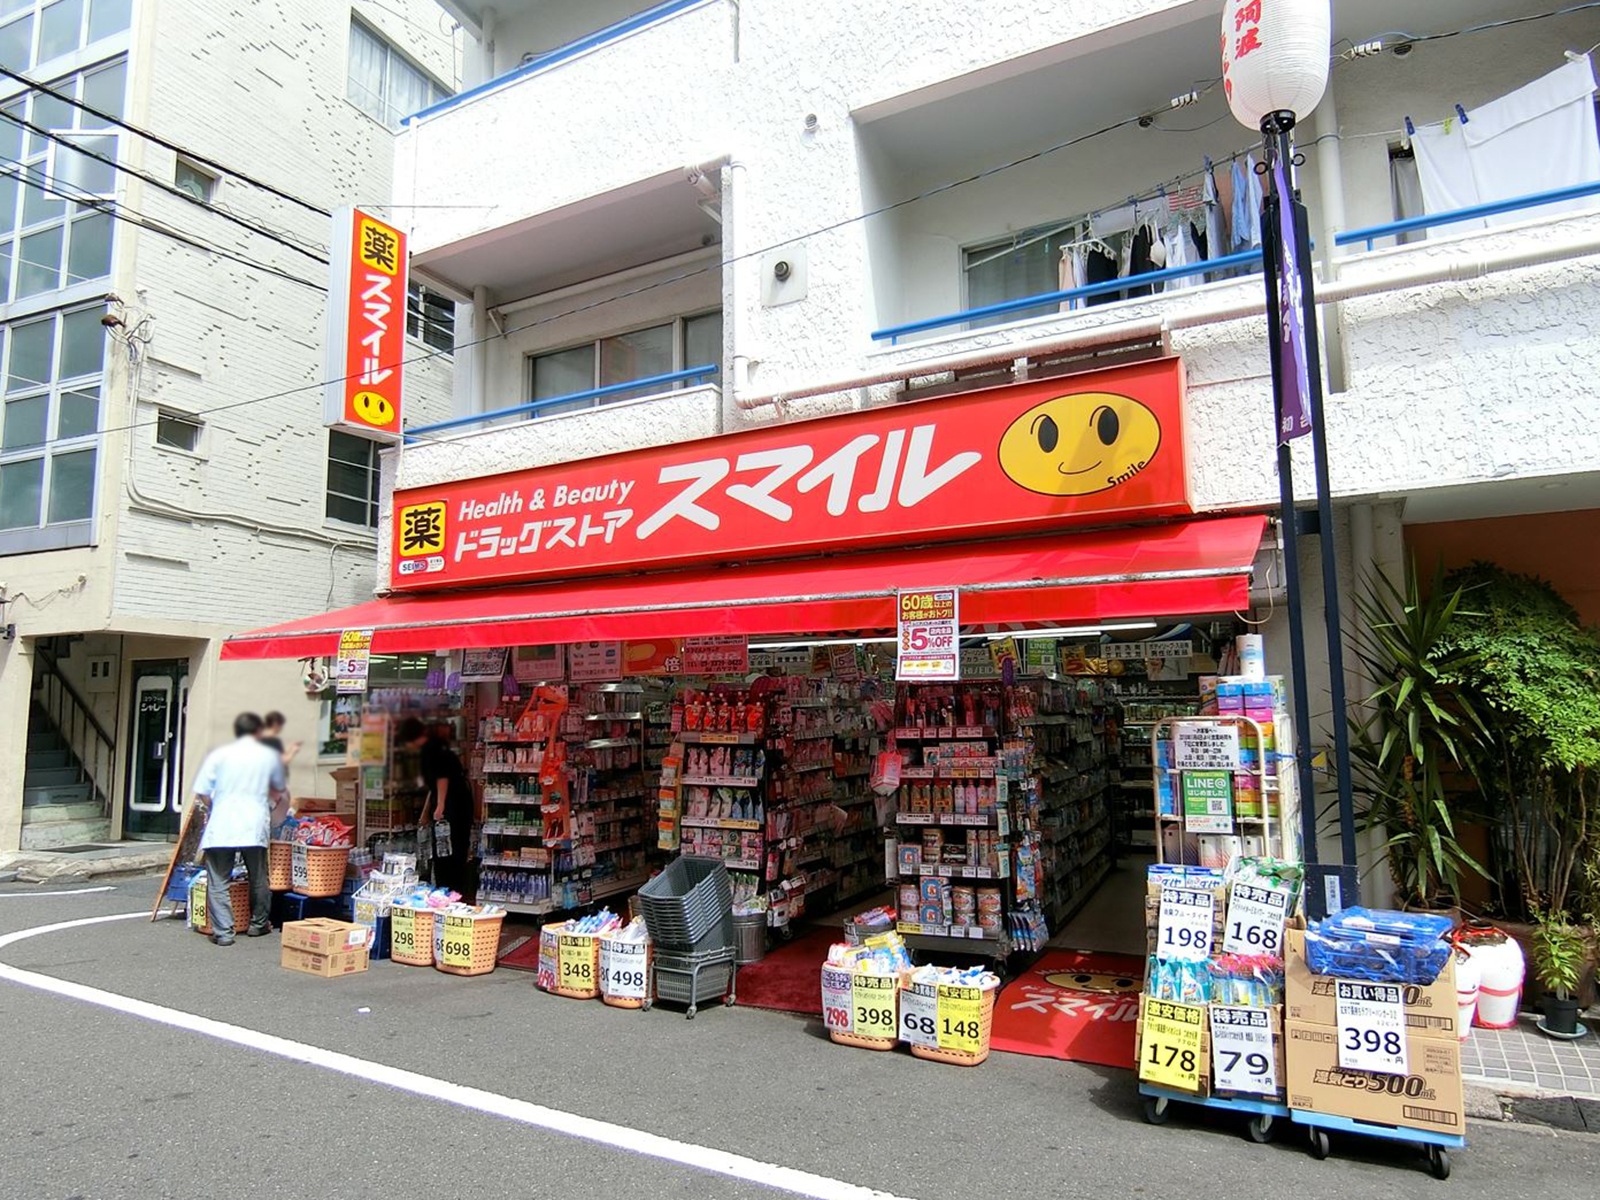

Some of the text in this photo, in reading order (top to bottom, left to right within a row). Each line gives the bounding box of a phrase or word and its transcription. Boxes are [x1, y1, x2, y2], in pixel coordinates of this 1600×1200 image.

[363, 225, 395, 271] 薬
[360, 274, 393, 385] スマイル
[636, 424, 982, 539] スマイル
[1107, 461, 1145, 486] Smile
[459, 479, 635, 521] Health & Beauty
[404, 506, 441, 550] 薬
[454, 508, 634, 562] ドラッグストア
[664, 655, 681, 672] 倍
[1186, 778, 1226, 789] LINE@
[294, 865, 307, 878] 599
[1164, 889, 1210, 907] 特売品
[1234, 884, 1284, 907] 特売品
[394, 931, 414, 945] 298
[1164, 926, 1207, 949] 198
[1232, 921, 1277, 949] 168
[445, 942, 470, 956] 698
[563, 962, 591, 978] 348
[612, 970, 643, 986] 498
[854, 974, 893, 990] 特売品
[1339, 982, 1400, 1003] お買い得品
[826, 1007, 849, 1027] 298
[856, 1006, 893, 1026] 398
[903, 1012, 935, 1035] 68
[1148, 1000, 1200, 1025] 激安価格
[1213, 1007, 1268, 1027] 特売品
[943, 1018, 979, 1039] 148
[1345, 1027, 1401, 1055] 398
[1148, 1043, 1195, 1072] 178
[1219, 1050, 1269, 1075] 79
